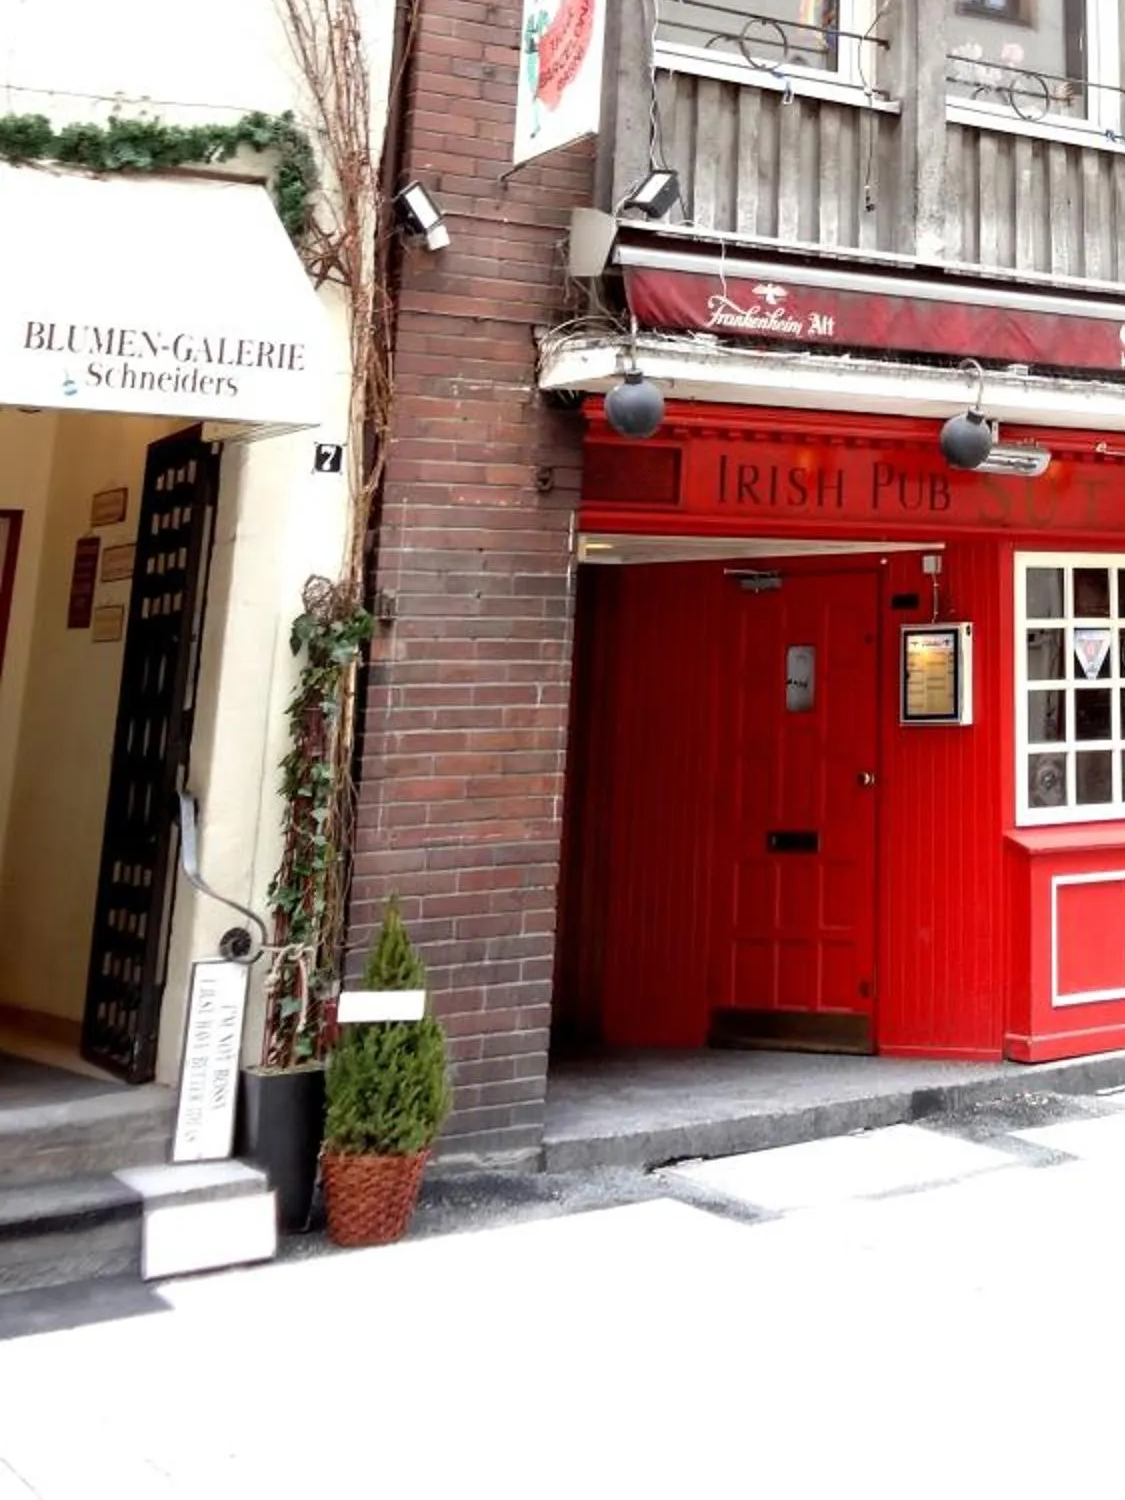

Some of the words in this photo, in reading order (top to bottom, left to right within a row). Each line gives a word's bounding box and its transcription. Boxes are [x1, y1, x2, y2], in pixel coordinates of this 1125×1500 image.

[706, 294, 804, 338] Frankenheim
[808, 312, 836, 336] Alt
[24, 320, 307, 371] BLUMEN-GALERIE
[86, 361, 240, 397] Schneiders
[320, 444, 337, 471] 7
[717, 453, 846, 511] IRISH
[870, 461, 953, 513] PUB
